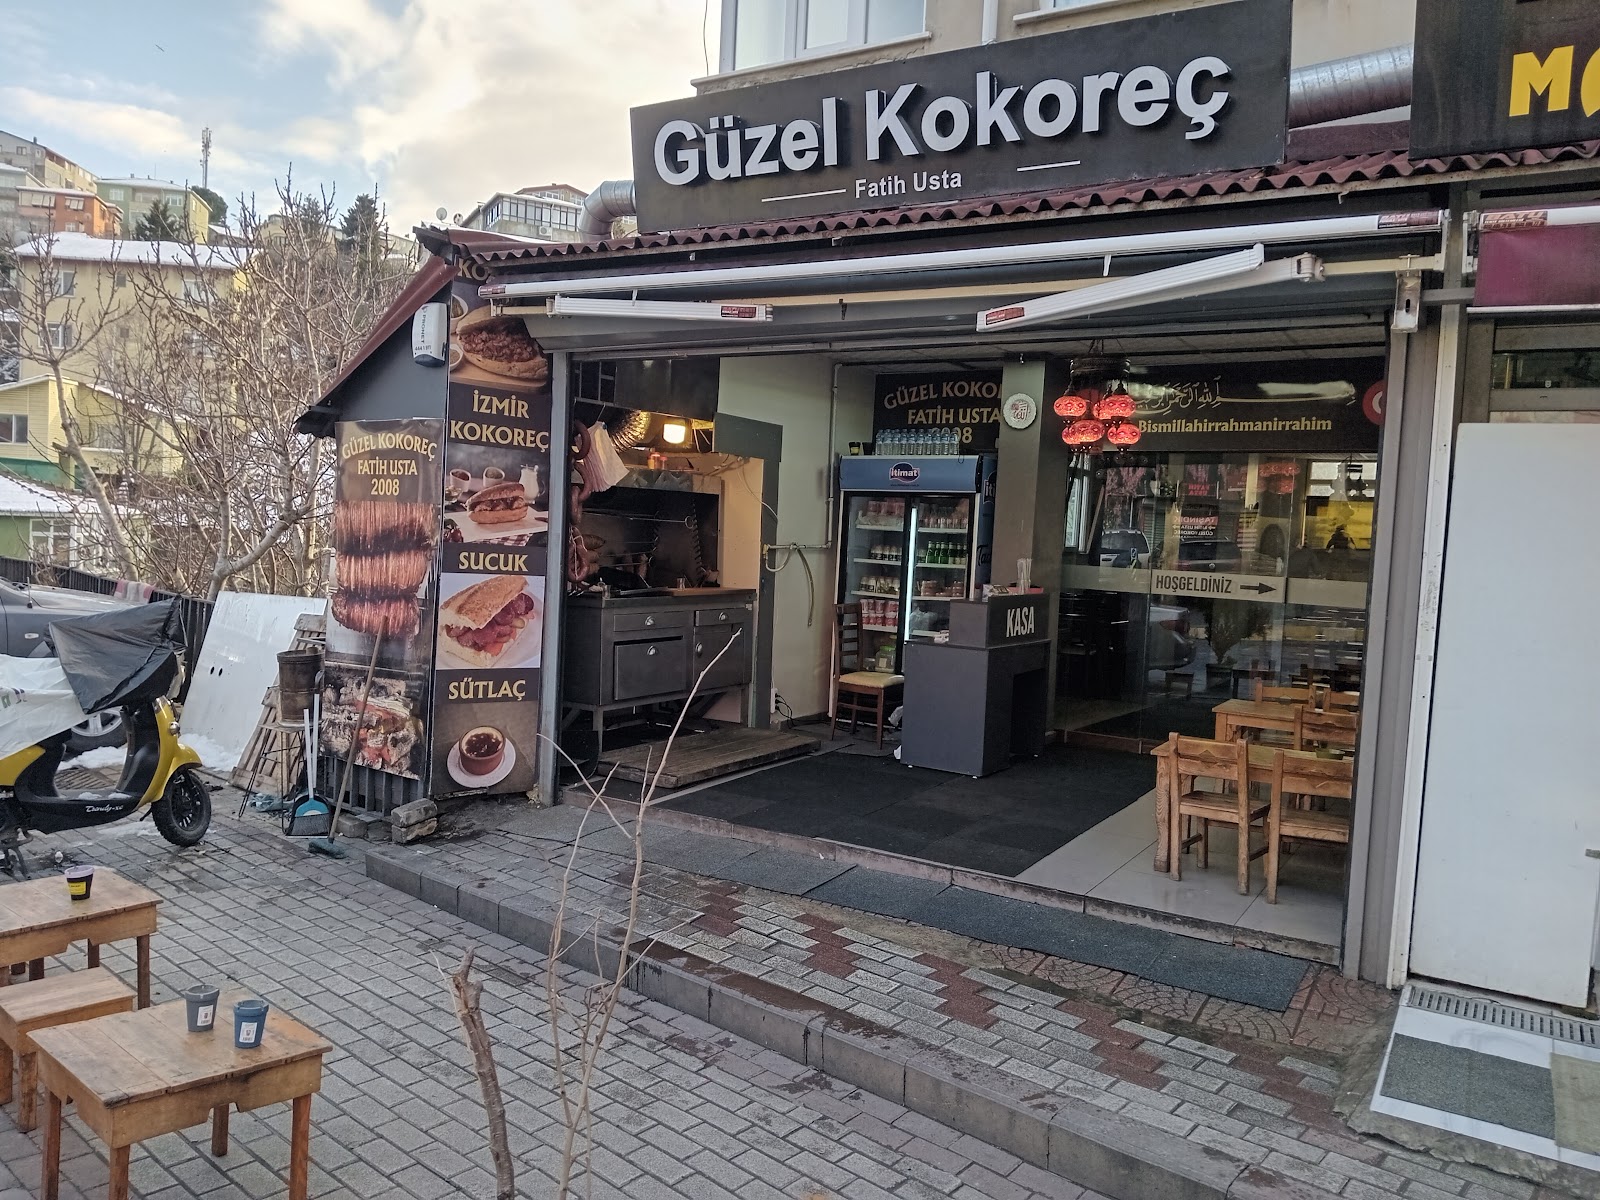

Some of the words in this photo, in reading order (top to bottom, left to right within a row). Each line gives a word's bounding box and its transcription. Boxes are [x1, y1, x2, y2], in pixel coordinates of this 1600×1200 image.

[653, 97, 840, 187] Güzel
[865, 55, 1231, 162] Kokoreç
[854, 174, 907, 199] Fatih
[912, 169, 963, 192] Usta
[472, 389, 529, 419] İZMİR
[884, 383, 938, 410] GÜZEL
[907, 404, 954, 425] FATİH
[958, 406, 1000, 424] USTA
[1137, 416, 1332, 433] Bismillahirrahmanirrahim
[341, 435, 377, 459] GÜZEL
[378, 432, 438, 461] KOKOREÇ
[450, 421, 549, 452] KOKOREÇ
[357, 456, 387, 475] FATİH
[390, 459, 418, 476] USTA
[370, 478, 400, 496] 2008
[458, 551, 529, 572] SUCUK
[1155, 573, 1232, 594] HOŞGELDİNİZ
[1005, 605, 1035, 638] KASA
[448, 677, 526, 701] SÜTLAÇ
